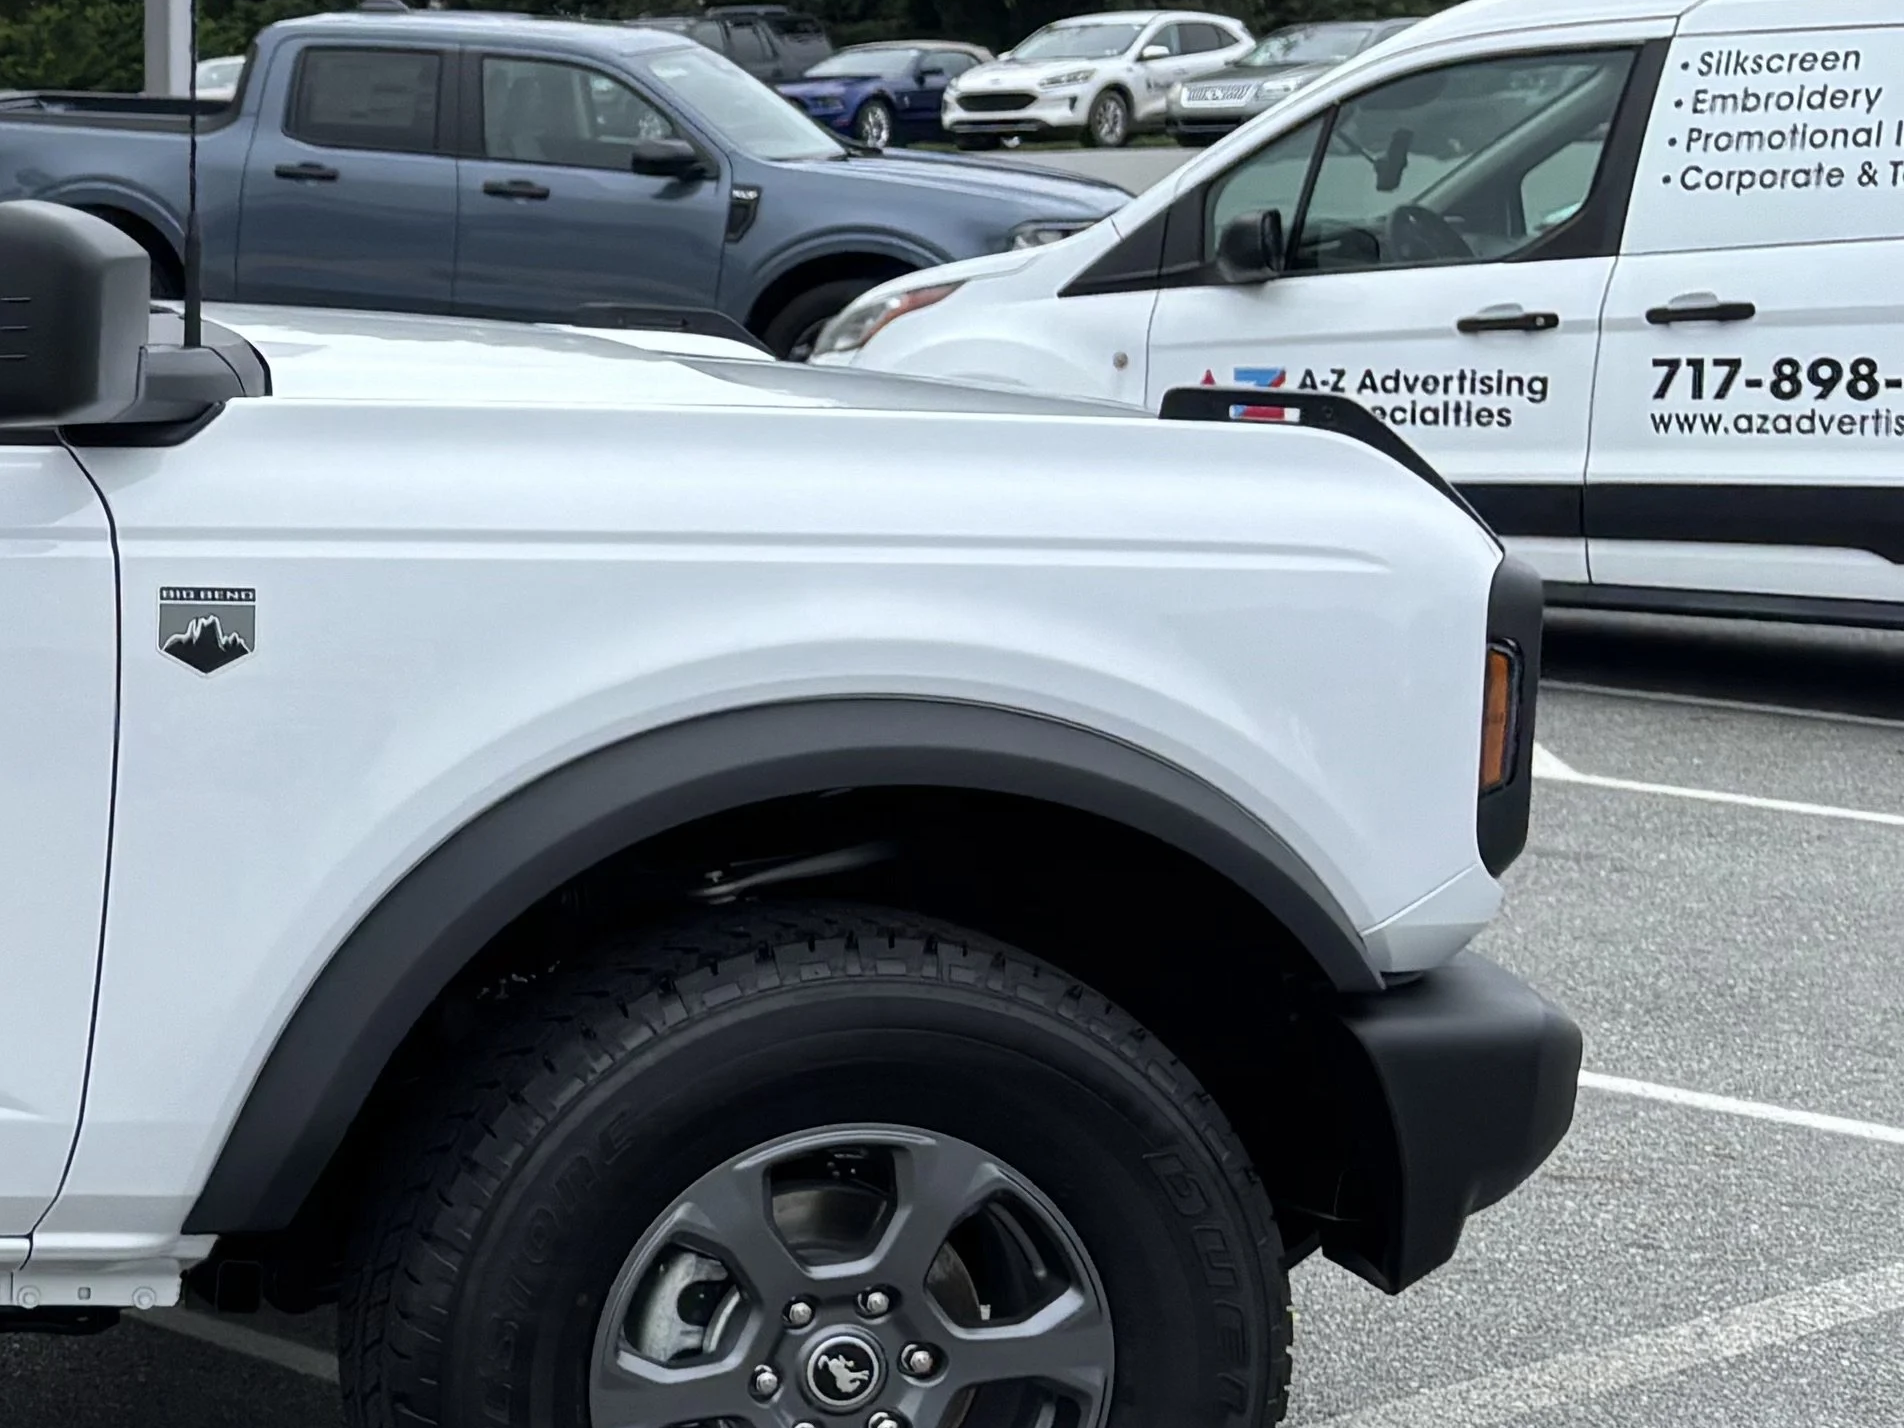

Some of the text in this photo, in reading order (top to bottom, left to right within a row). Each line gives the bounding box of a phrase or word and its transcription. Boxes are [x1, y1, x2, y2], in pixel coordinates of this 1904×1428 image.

[1697, 48, 1861, 77] Silkscreen
[1692, 83, 1883, 115] Embroidery
[1685, 119, 1884, 153] Promotional
[1680, 161, 1845, 196] Corporate
[1857, 160, 1879, 188] &
[1297, 368, 1346, 393] A-Z
[1356, 368, 1549, 403] Advertising
[1651, 357, 1903, 401] 717-898-
[1371, 400, 1512, 427] ecialties
